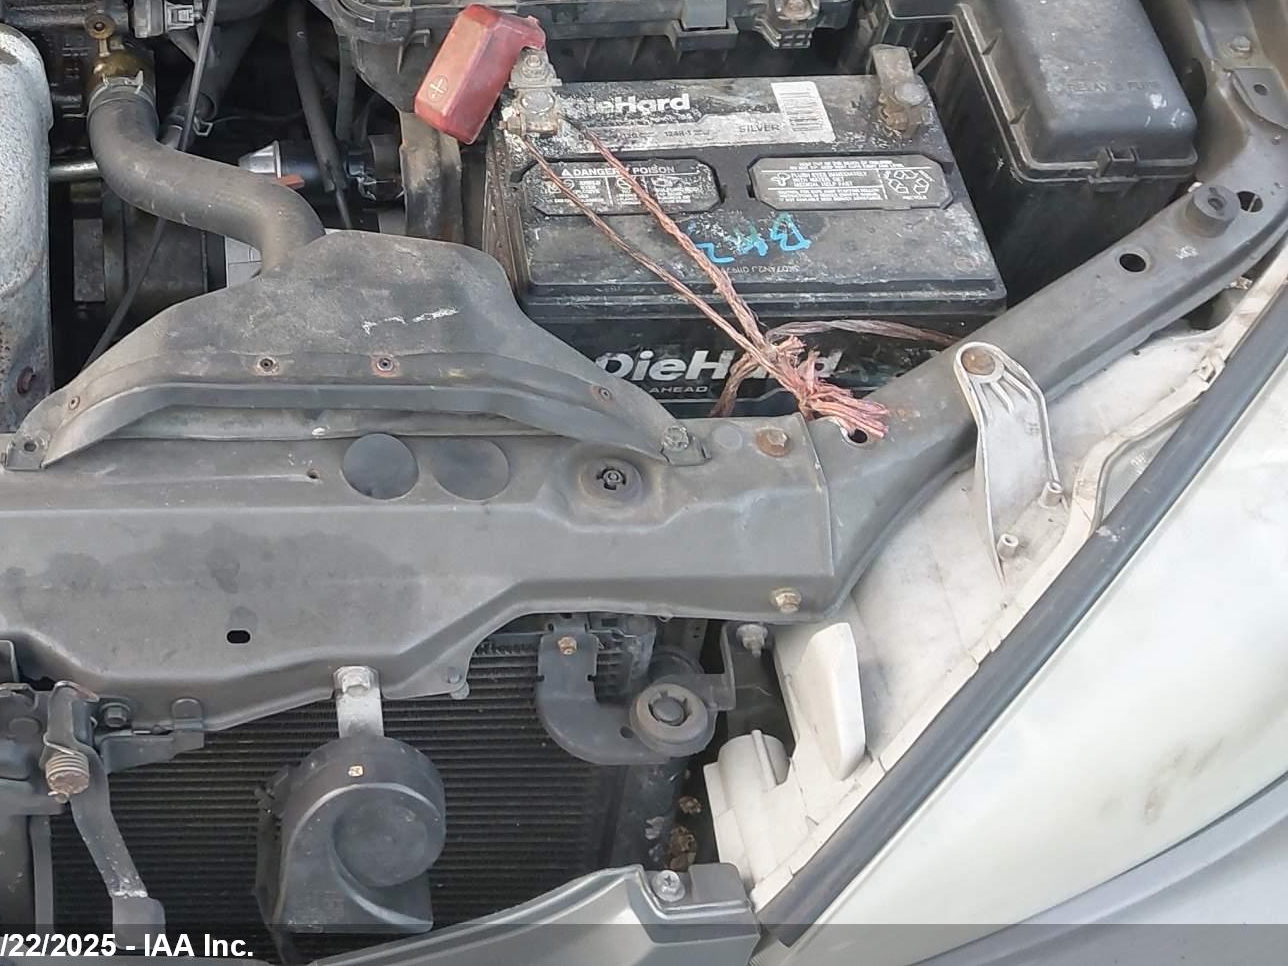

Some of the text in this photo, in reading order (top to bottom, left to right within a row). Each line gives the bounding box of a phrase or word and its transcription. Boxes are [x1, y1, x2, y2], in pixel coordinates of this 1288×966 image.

[738, 123, 781, 132] SILVER
[632, 165, 675, 175] POISON
[595, 349, 844, 381] DieHd
[648, 385, 709, 394] AHEAD
